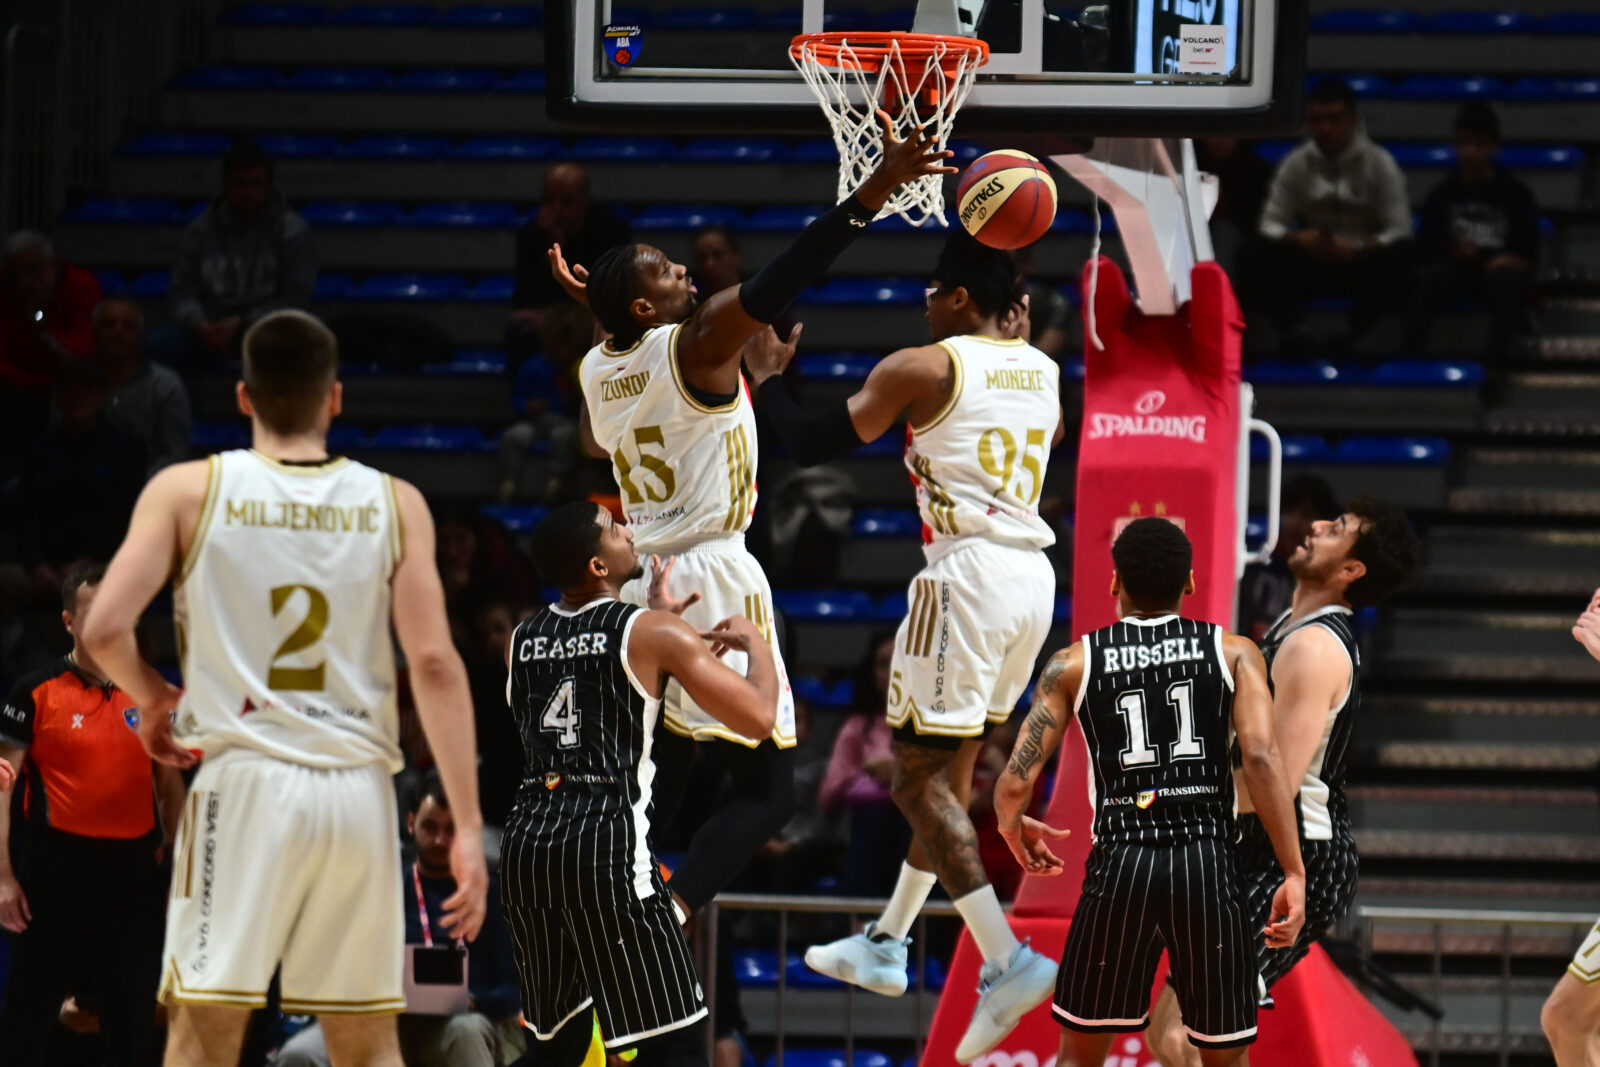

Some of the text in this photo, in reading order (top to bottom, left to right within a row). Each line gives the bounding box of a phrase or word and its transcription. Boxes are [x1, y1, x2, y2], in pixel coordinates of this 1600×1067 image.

[616, 37, 630, 47] ABA
[960, 177, 1005, 227] SPALDING
[985, 369, 1044, 391] MONEKE
[1089, 413, 1207, 444] SPALDING
[613, 425, 676, 504] 15
[977, 427, 1047, 506] 95
[226, 499, 380, 534] MILJENOVIĆ
[941, 581, 950, 614] WEST
[267, 583, 331, 692] 2
[519, 632, 608, 663] CEASER
[1104, 636, 1205, 674] RUSSELL
[3, 704, 26, 722] NLB
[540, 675, 582, 750] 4
[1115, 678, 1206, 772] 11
[1103, 795, 1135, 807] BANCA
